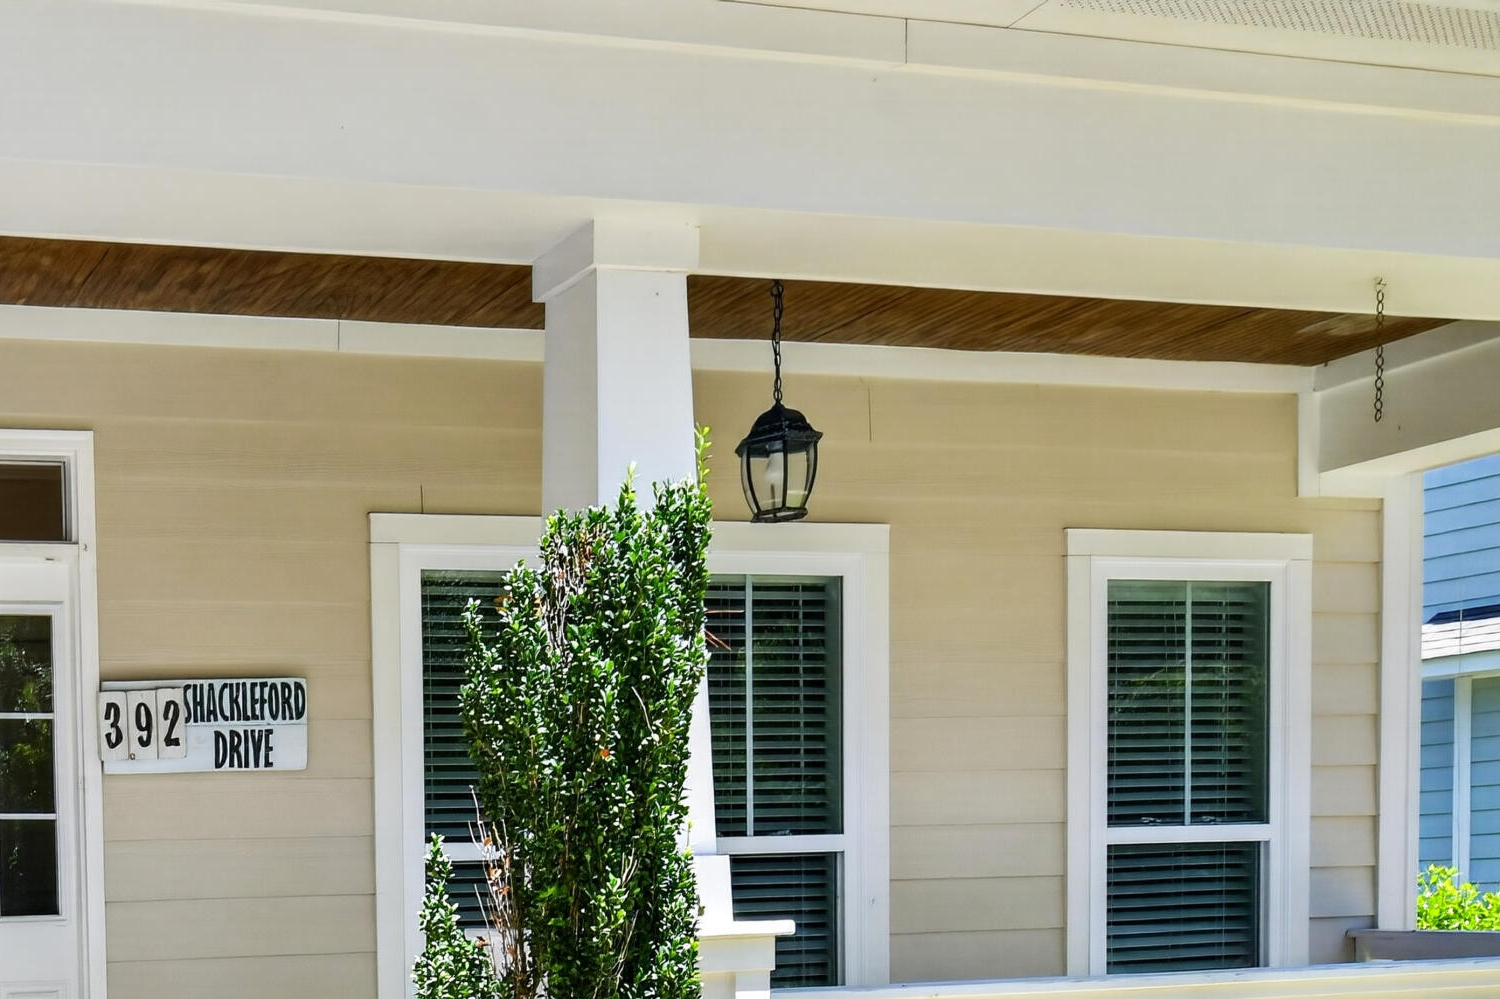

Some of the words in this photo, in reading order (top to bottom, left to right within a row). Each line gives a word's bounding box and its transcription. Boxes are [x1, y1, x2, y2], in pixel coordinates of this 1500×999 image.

[183, 681, 306, 724] SHACKLEFORD
[104, 700, 181, 749] 392
[214, 729, 274, 769] DRIVE
